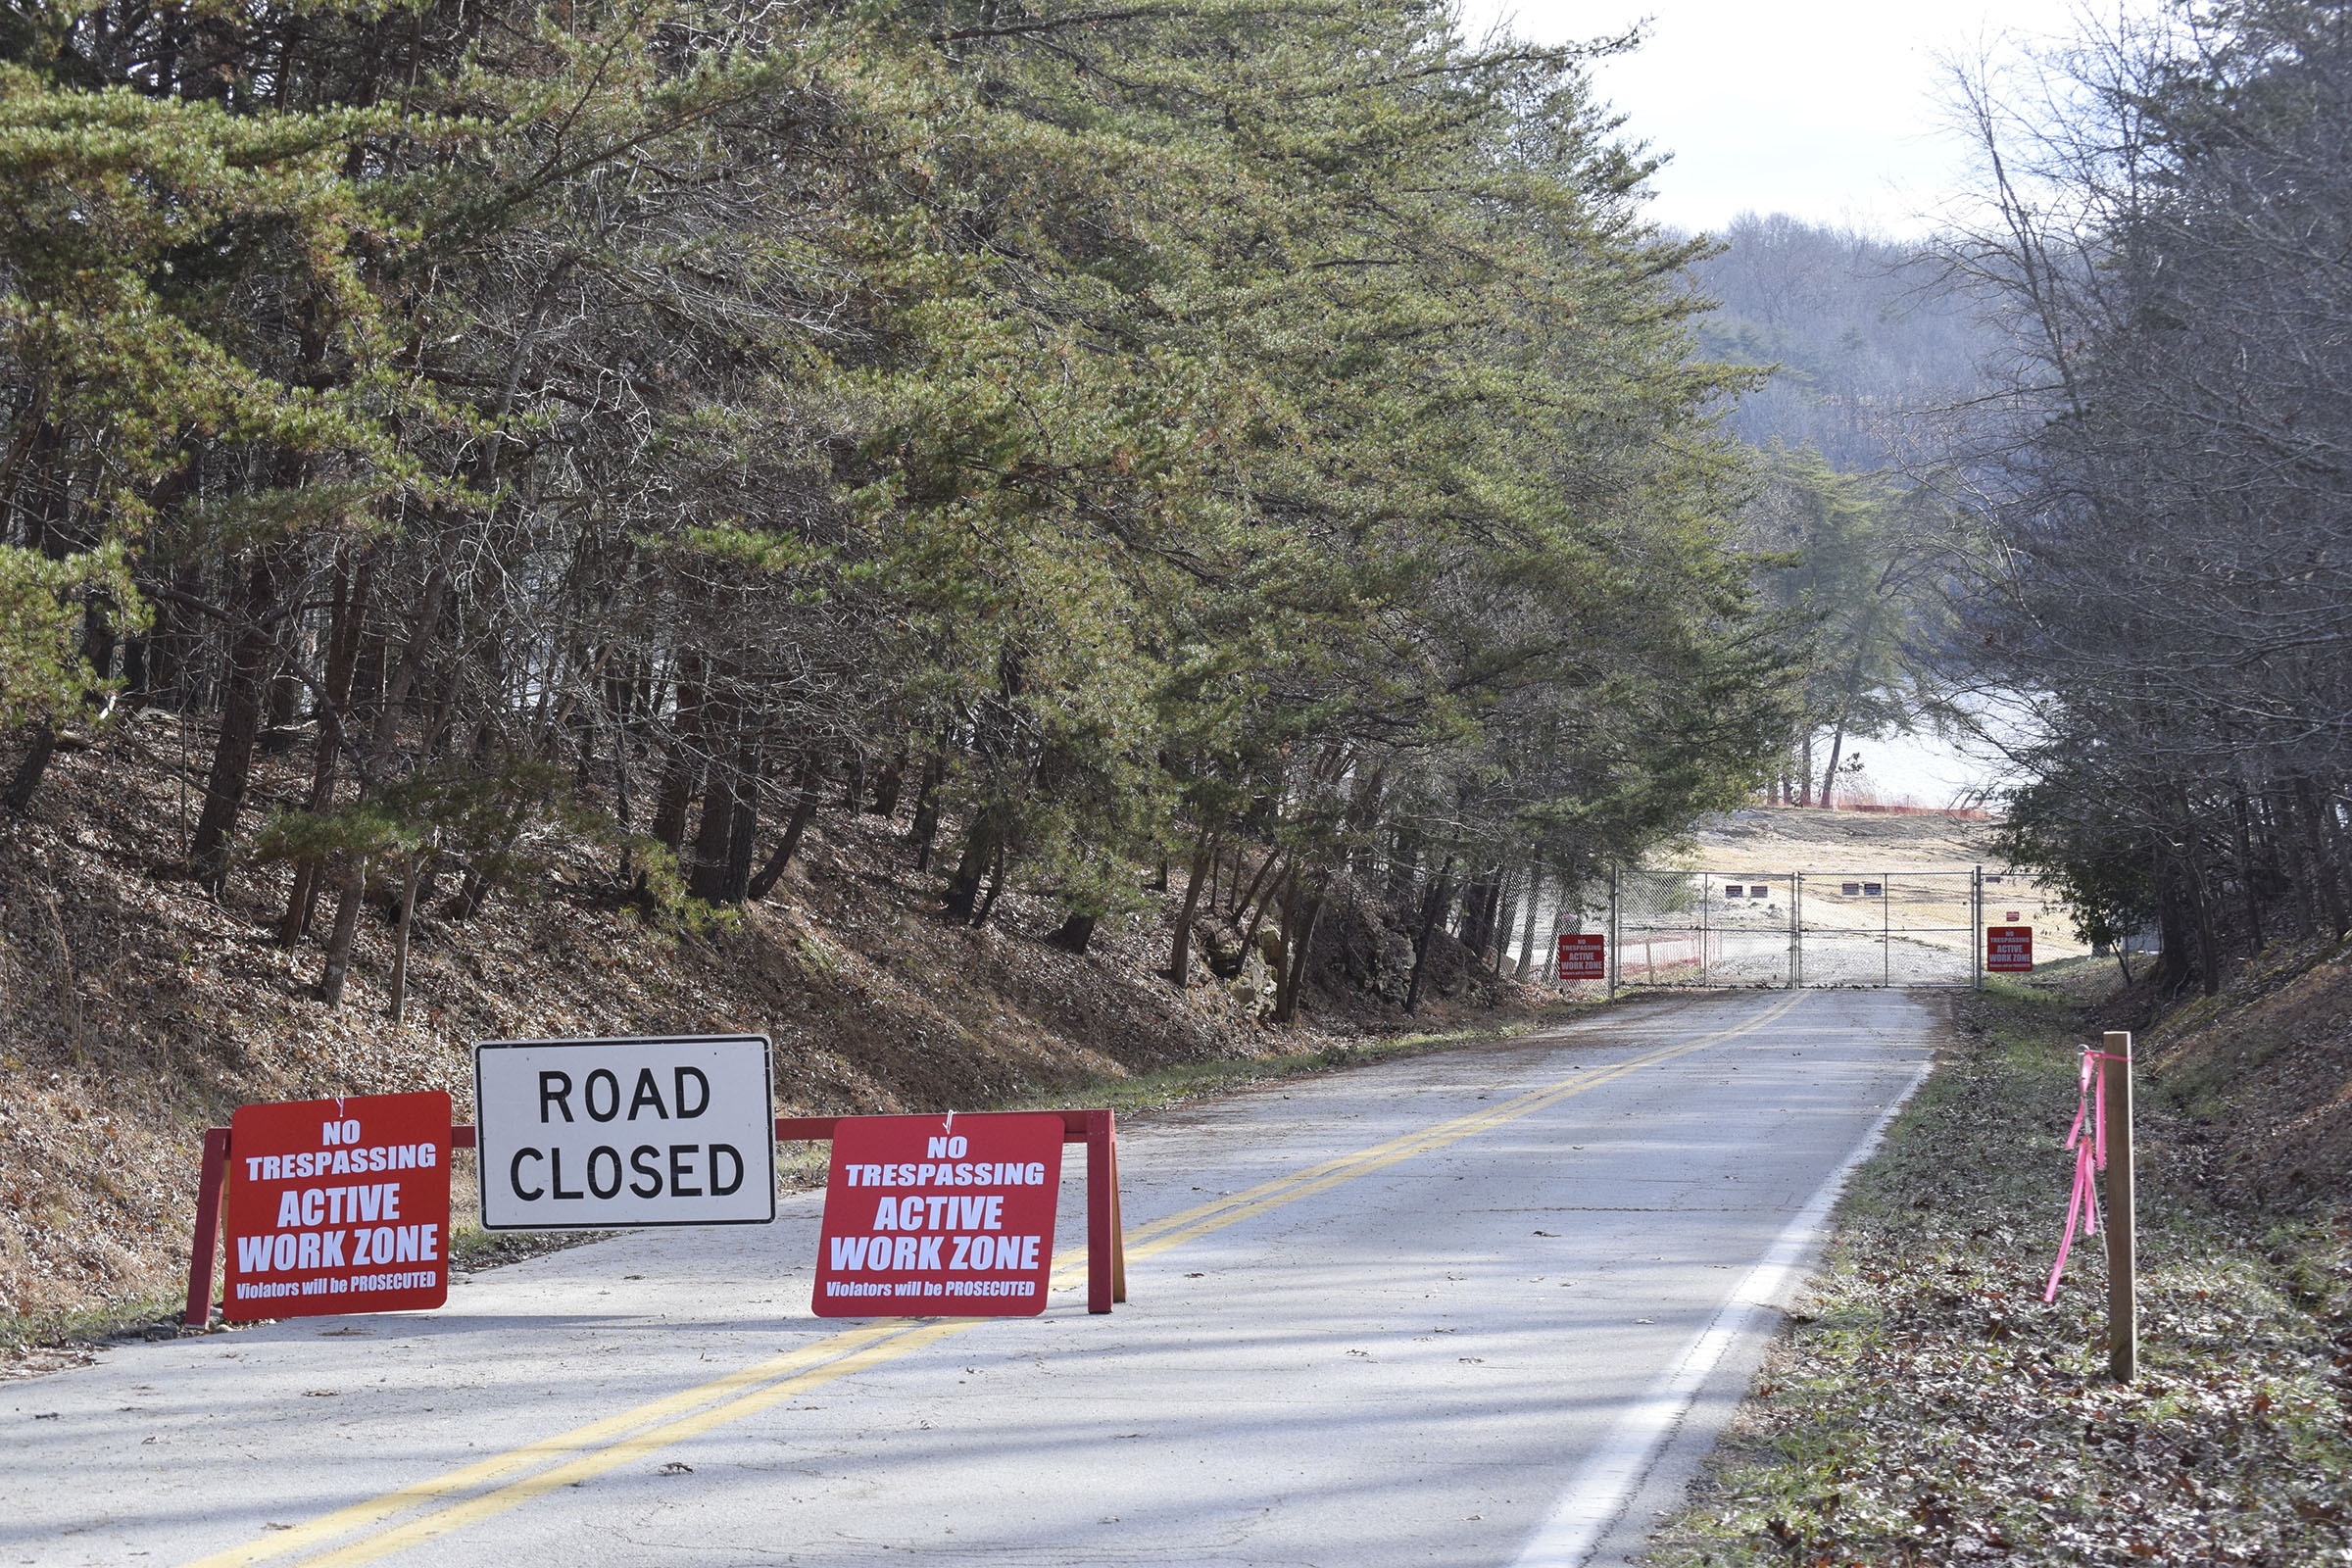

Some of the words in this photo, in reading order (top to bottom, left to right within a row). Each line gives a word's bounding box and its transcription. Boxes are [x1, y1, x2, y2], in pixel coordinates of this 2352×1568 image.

[1561, 961, 1584, 970] WORK
[1989, 954, 2011, 962] WORK
[2013, 954, 2032, 962] ZONE
[539, 1066, 710, 1124] ROAD
[322, 1119, 361, 1147] NO
[927, 1136, 968, 1159] NO
[246, 1143, 436, 1182] TRESPASSING
[511, 1143, 744, 1201] CLOSED
[845, 1162, 1045, 1187] TRESPASSING
[276, 1183, 401, 1228] ACTIVE
[873, 1196, 1004, 1231] ACTIVE
[236, 1233, 346, 1274] WORK
[352, 1224, 438, 1264] ZONE
[831, 1236, 946, 1271] WORK
[949, 1236, 1041, 1270] ZONE
[235, 1281, 299, 1300] Violators
[302, 1279, 327, 1295] will
[329, 1277, 348, 1294] be
[350, 1270, 436, 1293] PROSECUTED
[826, 1281, 893, 1297] Violators
[895, 1281, 921, 1297] will
[924, 1281, 943, 1297] be
[945, 1281, 1036, 1297] PROSECUTED
